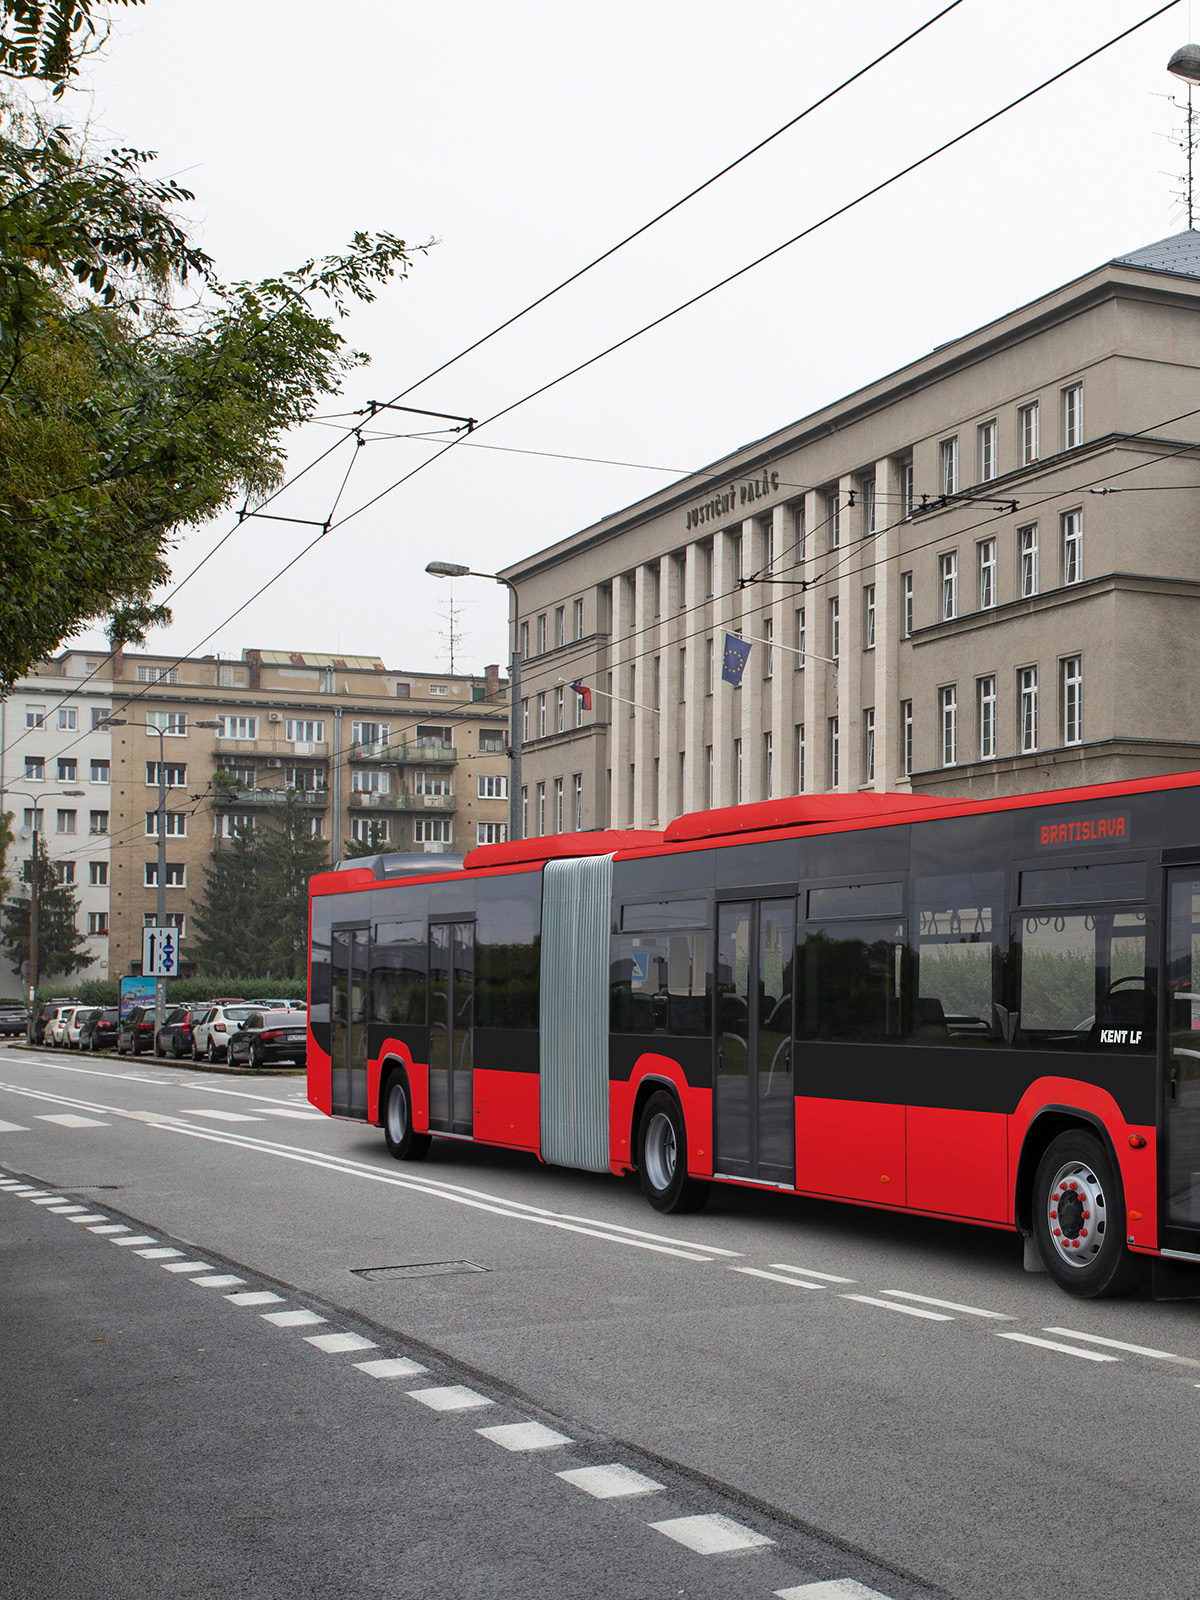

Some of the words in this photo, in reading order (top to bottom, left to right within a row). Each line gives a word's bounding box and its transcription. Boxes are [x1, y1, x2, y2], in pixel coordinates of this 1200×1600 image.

[740, 469, 779, 505] PALÁC
[1041, 817, 1125, 845] BRATISLAVA
[1100, 1030, 1128, 1044] KENT
[1130, 1031, 1142, 1044] LF
